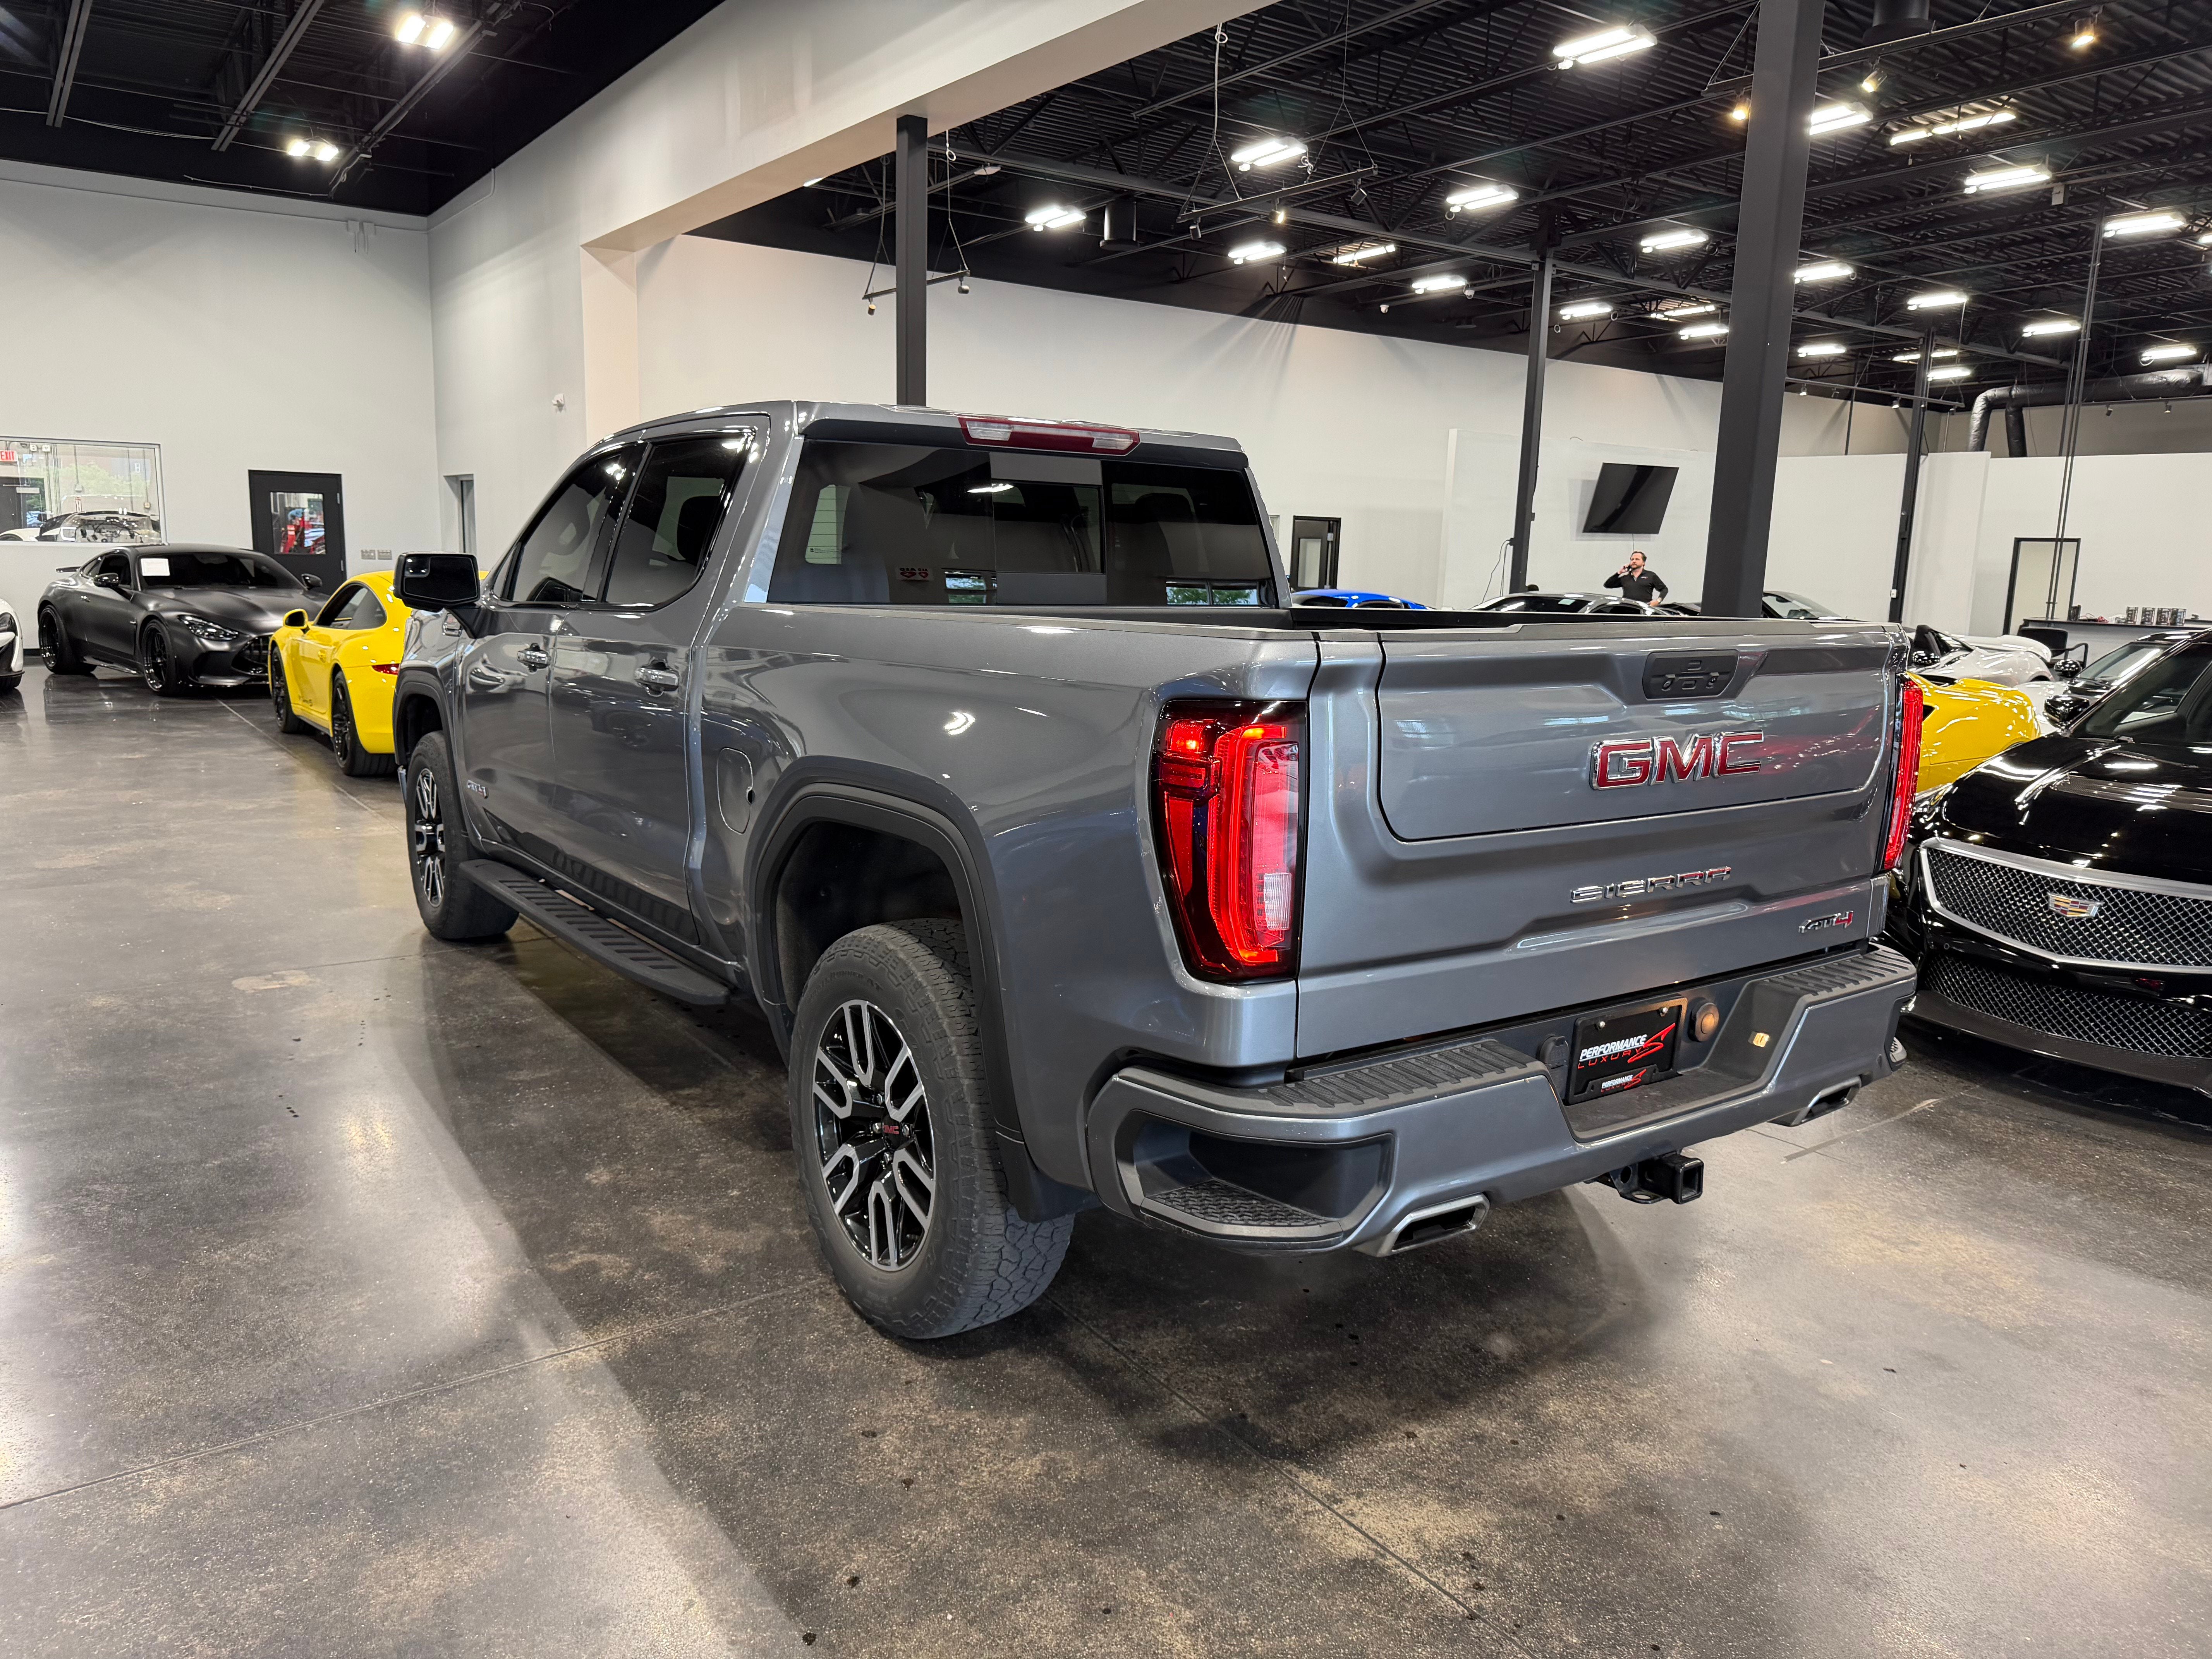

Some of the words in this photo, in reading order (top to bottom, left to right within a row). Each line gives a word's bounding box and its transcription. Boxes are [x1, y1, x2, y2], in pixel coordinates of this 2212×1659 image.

[0, 451, 14, 460] EXIT
[1589, 729, 1764, 790] GMC
[1570, 866, 1731, 903] SIERRA
[1798, 910, 1854, 934] AT4
[1577, 1047, 1642, 1070] LUXURY
[1580, 1034, 1647, 1060] PERFORMANCE
